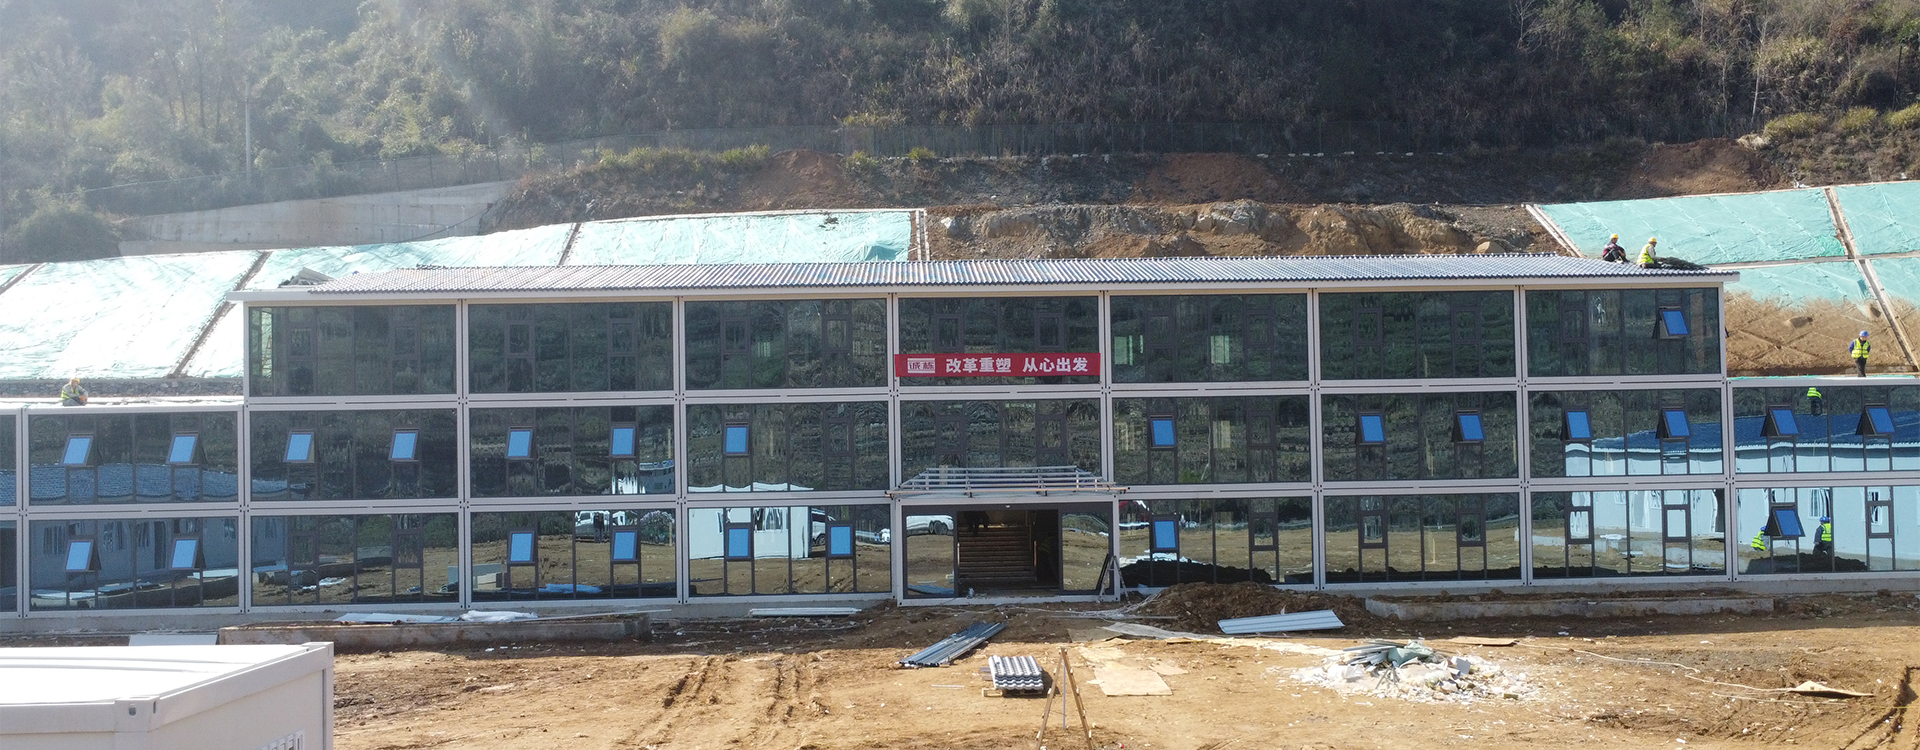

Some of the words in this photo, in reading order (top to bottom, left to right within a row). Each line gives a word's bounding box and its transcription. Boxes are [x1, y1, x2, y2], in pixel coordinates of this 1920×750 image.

[946, 357, 1011, 373] 改革重塑
[1023, 357, 1088, 373] 从心出发
